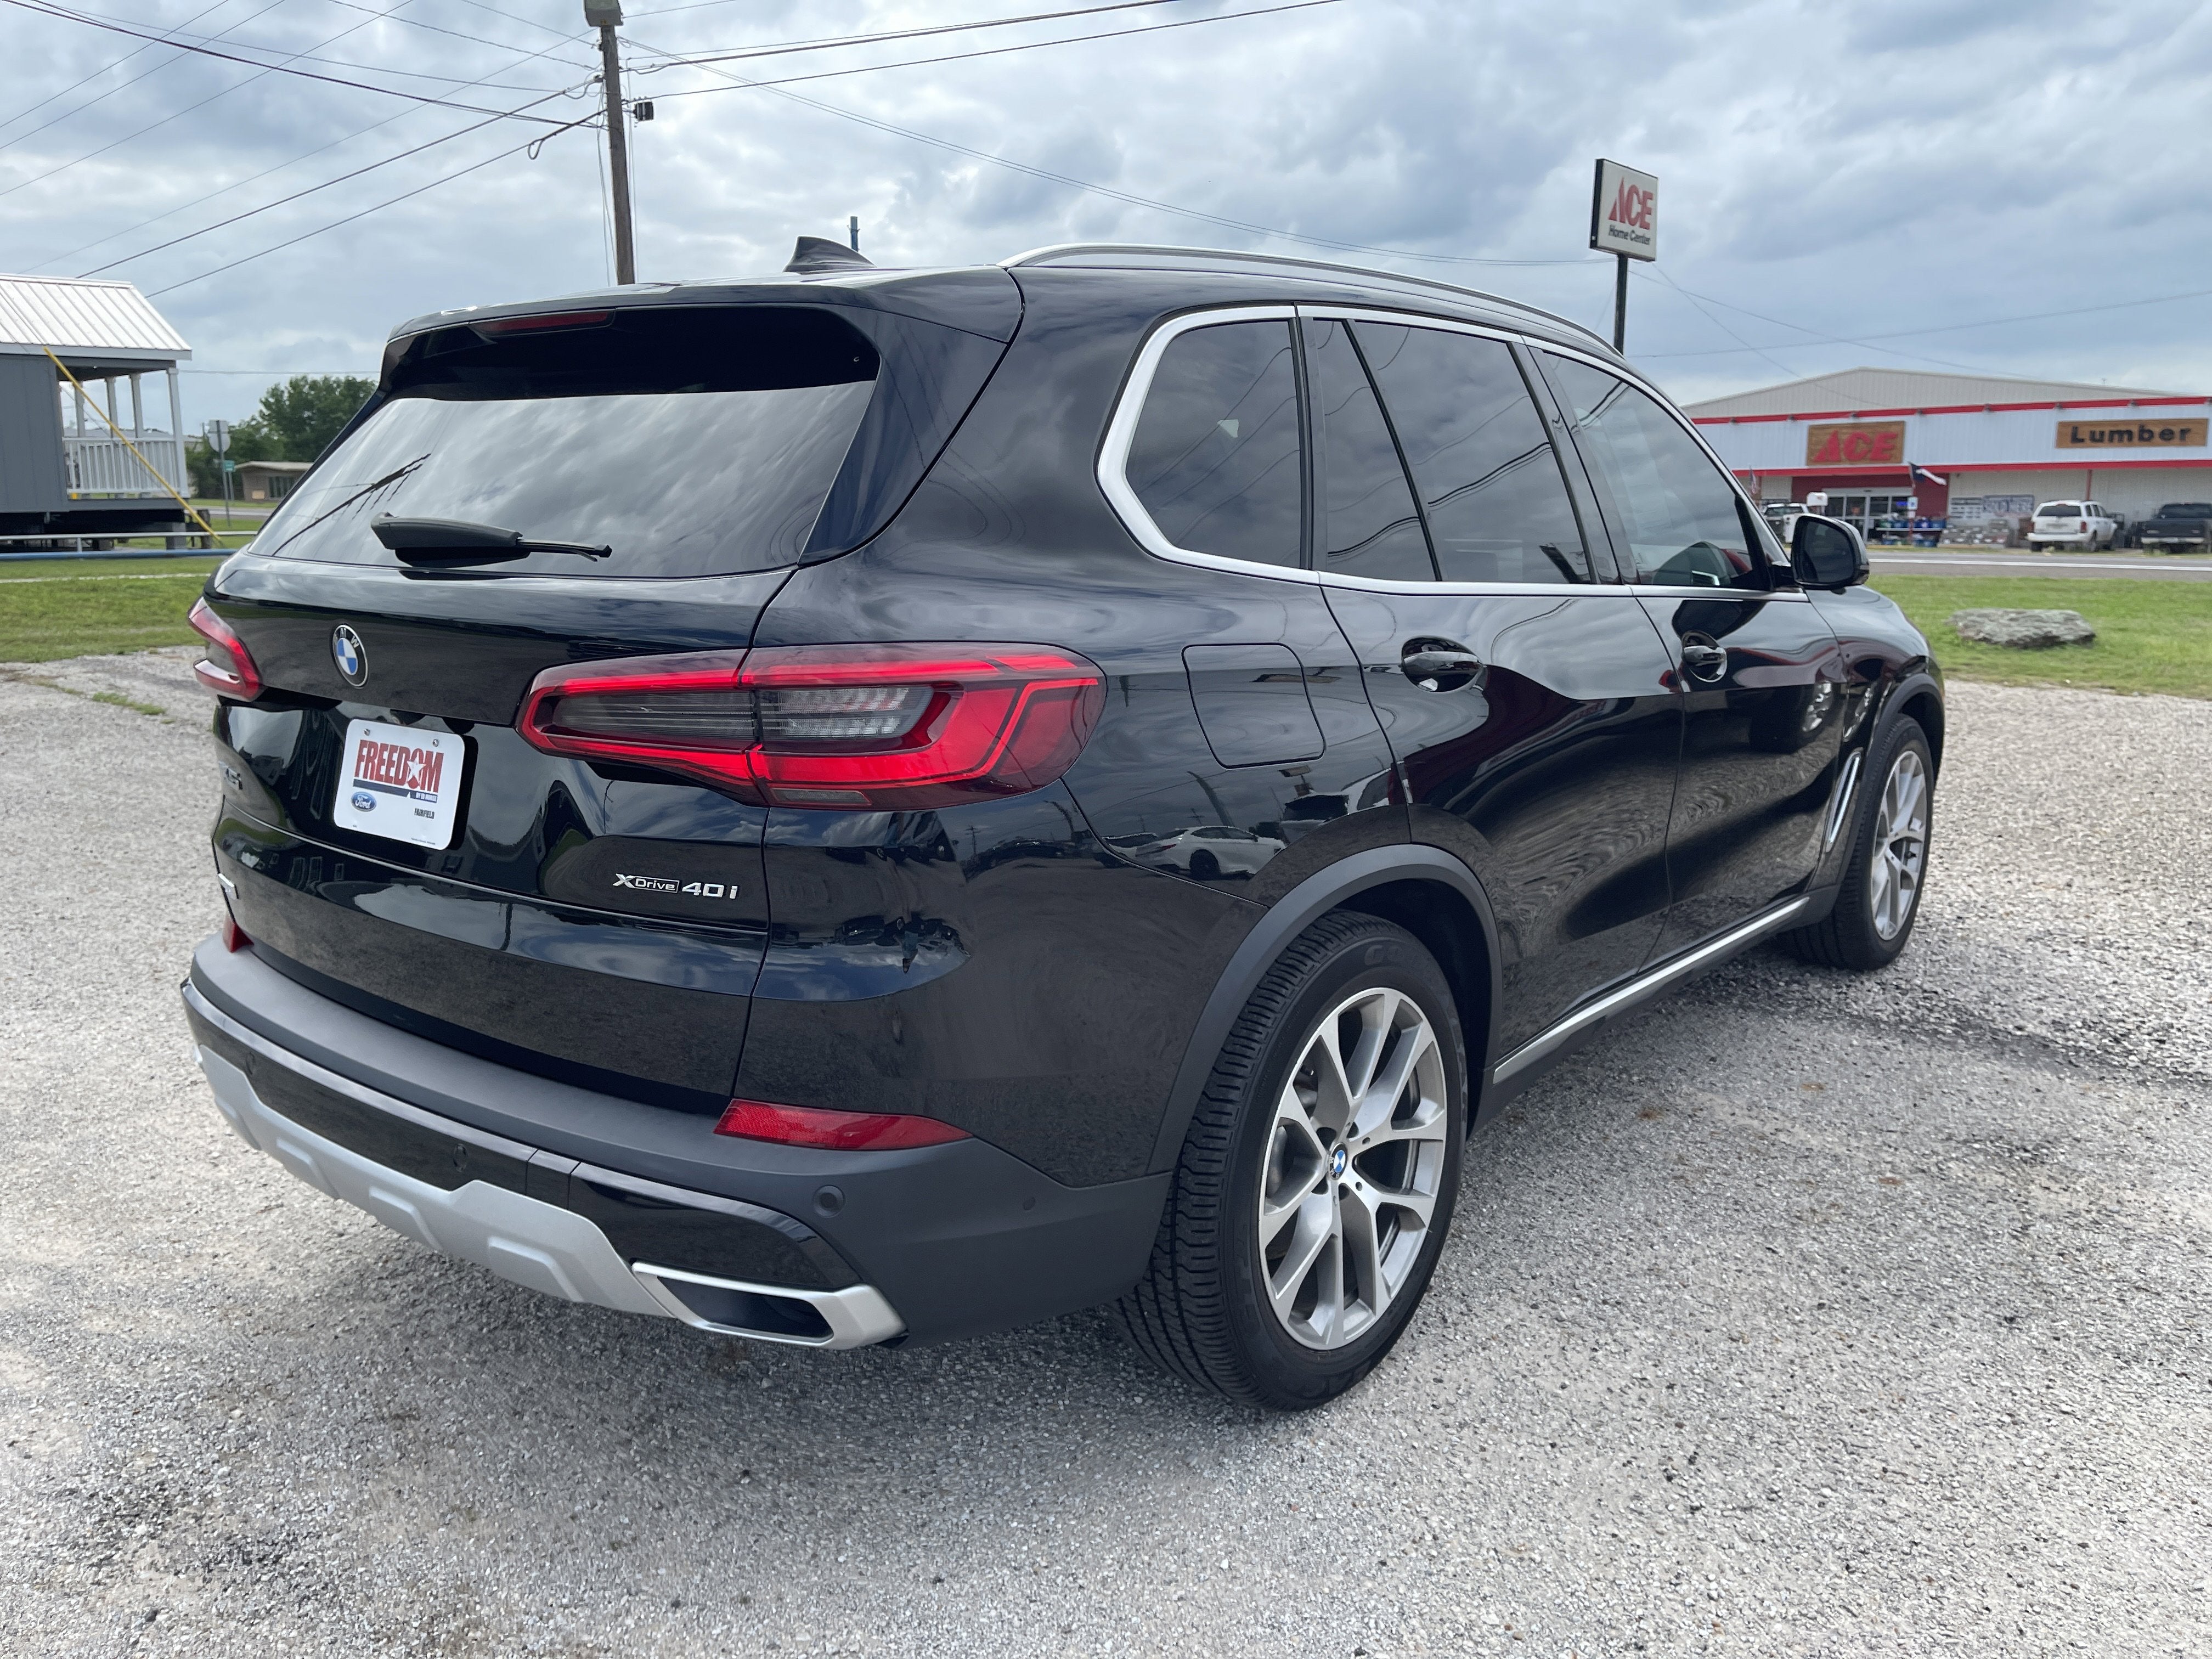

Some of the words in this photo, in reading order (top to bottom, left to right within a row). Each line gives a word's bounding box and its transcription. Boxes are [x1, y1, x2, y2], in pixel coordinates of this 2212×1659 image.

[1608, 177, 1654, 230] ACE
[1608, 224, 1628, 240] Home
[1629, 229, 1651, 245] Center
[2070, 424, 2192, 444] Lumber
[1813, 430, 1899, 462] ACE
[332, 628, 360, 648] BMW
[354, 739, 444, 793] FREEDOM
[354, 794, 372, 809] Ford
